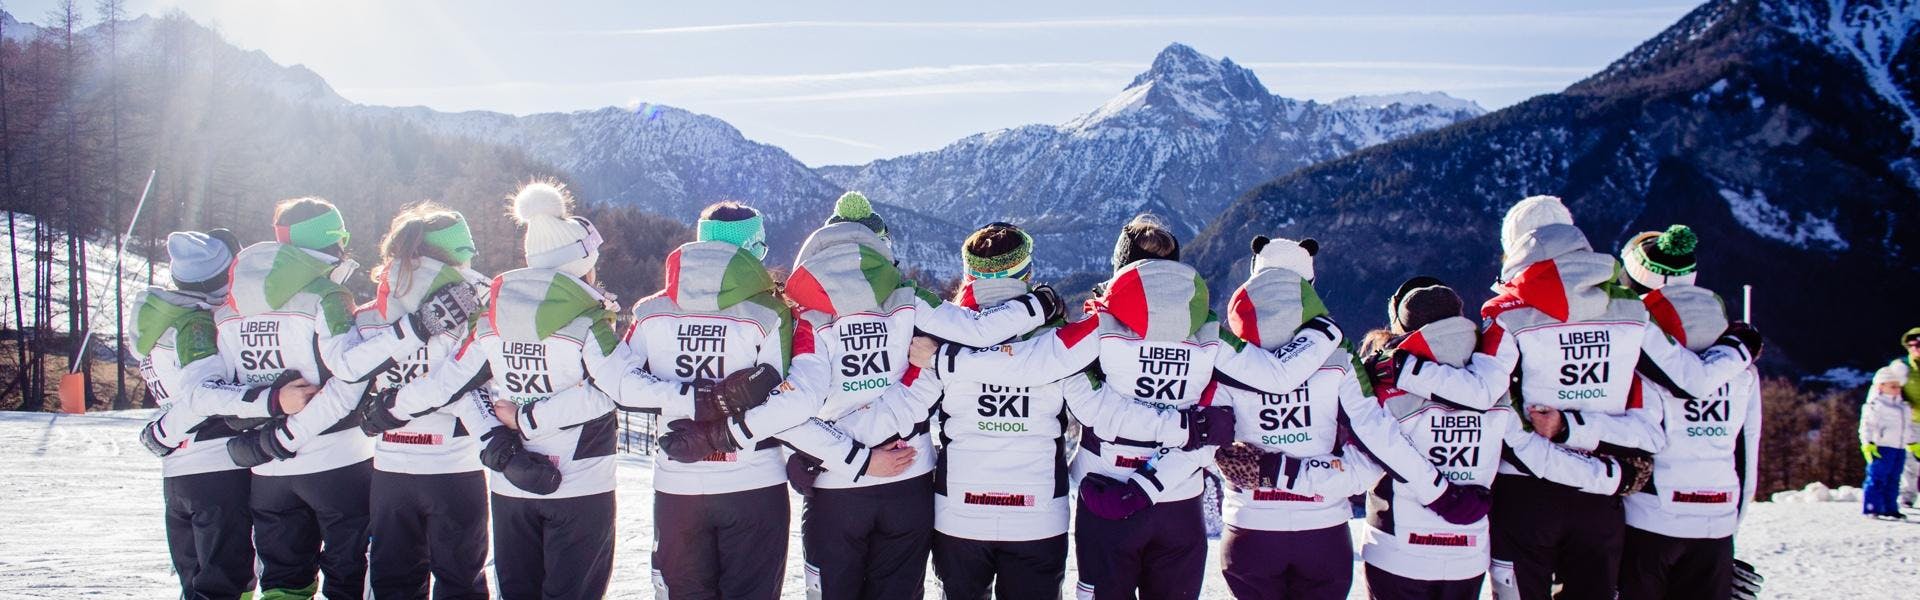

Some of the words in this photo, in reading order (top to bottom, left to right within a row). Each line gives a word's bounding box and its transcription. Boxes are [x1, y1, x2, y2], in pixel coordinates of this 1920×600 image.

[240, 321, 280, 333] LIBERI
[677, 324, 728, 337] LIBERI
[839, 322, 888, 337] LIBERI
[240, 333, 280, 347] TUTTI
[677, 337, 726, 352] TUTTI
[840, 334, 888, 352] TUTTI
[1559, 330, 1610, 346] LIBERI
[502, 341, 547, 357] LIBERI
[1139, 346, 1191, 361] LIBERI
[1560, 344, 1610, 360] TUTTI
[240, 350, 286, 370] SKI
[502, 355, 548, 371] TUTTI
[675, 354, 725, 379] SKI
[840, 350, 892, 377] SKI
[1138, 360, 1190, 376] TUTTI
[1559, 361, 1610, 386] SKI
[505, 371, 554, 394] SKI
[842, 378, 892, 392] SCHOOL
[1134, 376, 1188, 400] SKI
[1558, 389, 1607, 400] SCHOOL
[977, 394, 1030, 418] SKI
[1683, 399, 1730, 422] SKI
[1259, 405, 1312, 431] SKI
[1430, 415, 1481, 428] LIBERI
[977, 421, 1029, 432] SCHOOL
[1686, 426, 1729, 437] SCOOL
[1261, 431, 1313, 445] SCHOOL
[1430, 429, 1482, 443] TUTTI
[1428, 446, 1480, 467] SKI
[1441, 471, 1475, 480] HOOL
